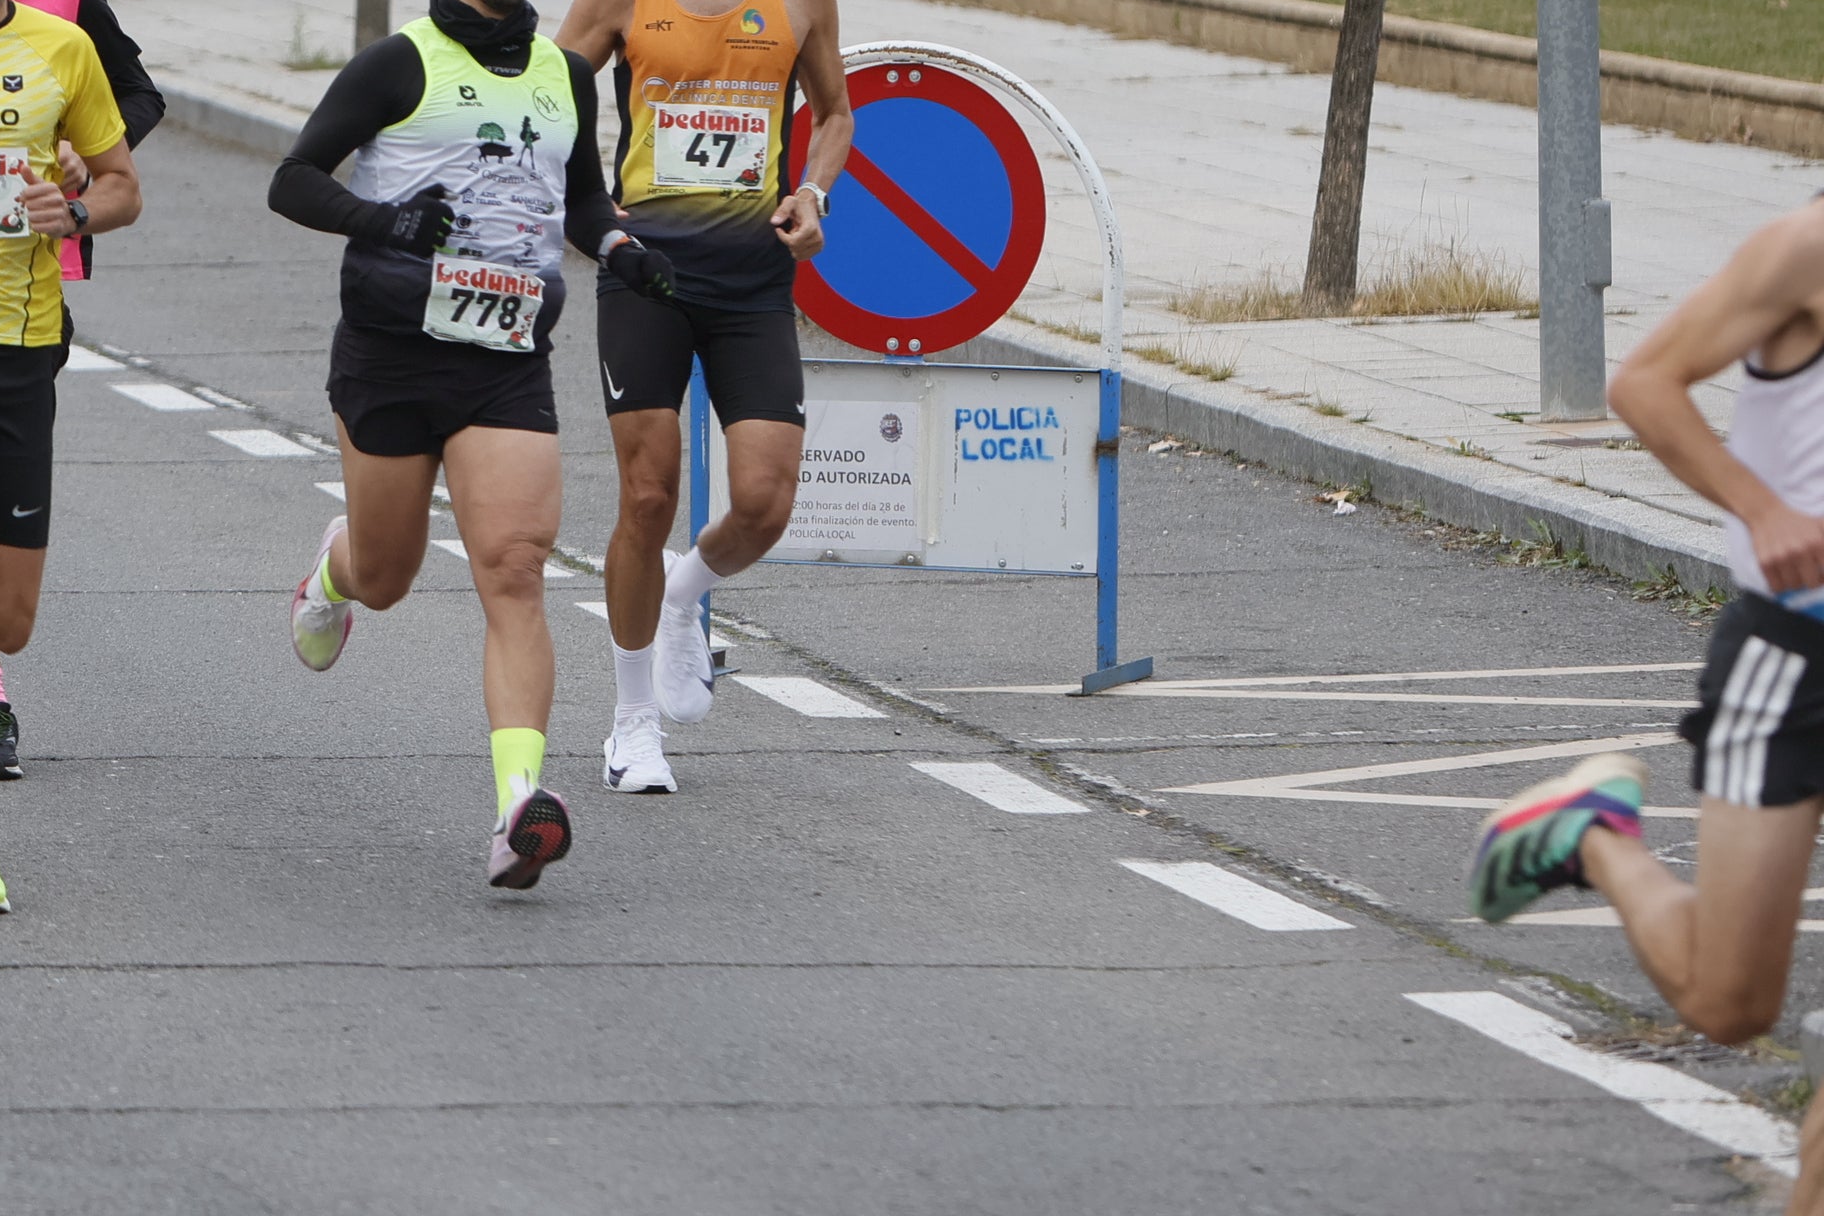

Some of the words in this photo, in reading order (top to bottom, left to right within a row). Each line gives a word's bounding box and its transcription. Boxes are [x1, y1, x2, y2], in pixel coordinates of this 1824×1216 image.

[674, 79, 711, 90] ESTER
[714, 80, 780, 91] RODRIGUEZ
[731, 95, 777, 105] DENTAL
[658, 109, 766, 134] bedunia
[685, 132, 737, 168] 47
[450, 288, 522, 331] 778
[955, 406, 1060, 430] POLICIA
[961, 437, 1055, 460] LOCAL
[799, 449, 866, 463] SERVADO
[816, 471, 912, 485] AUTORIZADA
[816, 500, 842, 511] horas
[845, 501, 860, 512] del
[862, 501, 877, 512] día
[879, 502, 891, 512] 28
[893, 502, 906, 512] de
[789, 516, 809, 525] asta
[811, 515, 864, 526] finalización
[866, 515, 879, 526] de
[881, 518, 918, 528] evento.
[789, 528, 825, 539] POLICÍA
[827, 529, 857, 540] LOCAL
